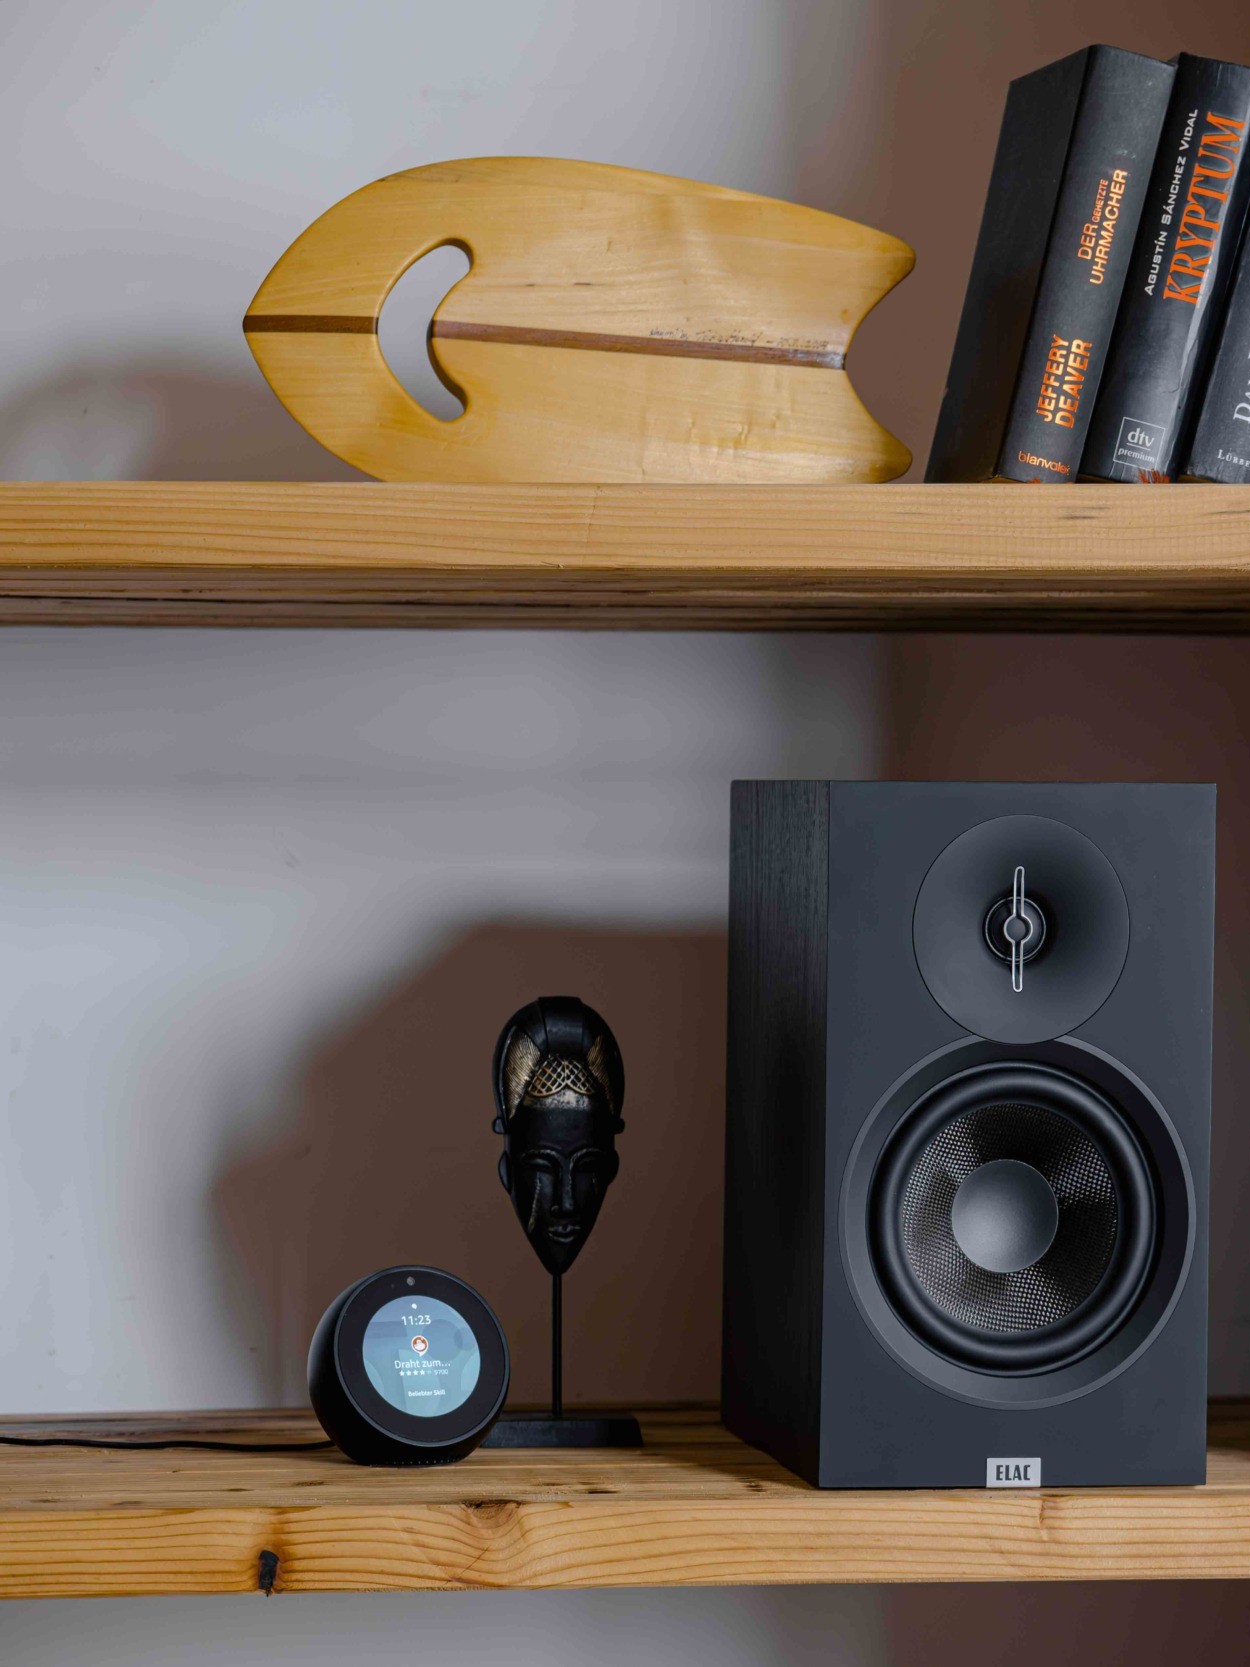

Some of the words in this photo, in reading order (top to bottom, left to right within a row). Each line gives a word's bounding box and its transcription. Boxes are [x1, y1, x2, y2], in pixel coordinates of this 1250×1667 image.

[1078, 223, 1098, 260] DER
[1092, 179, 1108, 222] GEHETZTE
[1089, 169, 1128, 285] UHRMACHER
[1144, 231, 1168, 296] AGUSTÍN
[1161, 155, 1187, 225] SÁNCHEZ
[1179, 109, 1198, 151] VIDAL
[1162, 111, 1245, 305] KRYPTUM
[1036, 334, 1069, 422] JEFFERY
[1054, 339, 1092, 428] DEAVER
[1117, 447, 1155, 464] premium
[1127, 427, 1155, 447] dtv
[401, 1315, 431, 1326] 11:23
[394, 1359, 420, 1369] Draht
[996, 1464, 1031, 1481] ELAC
